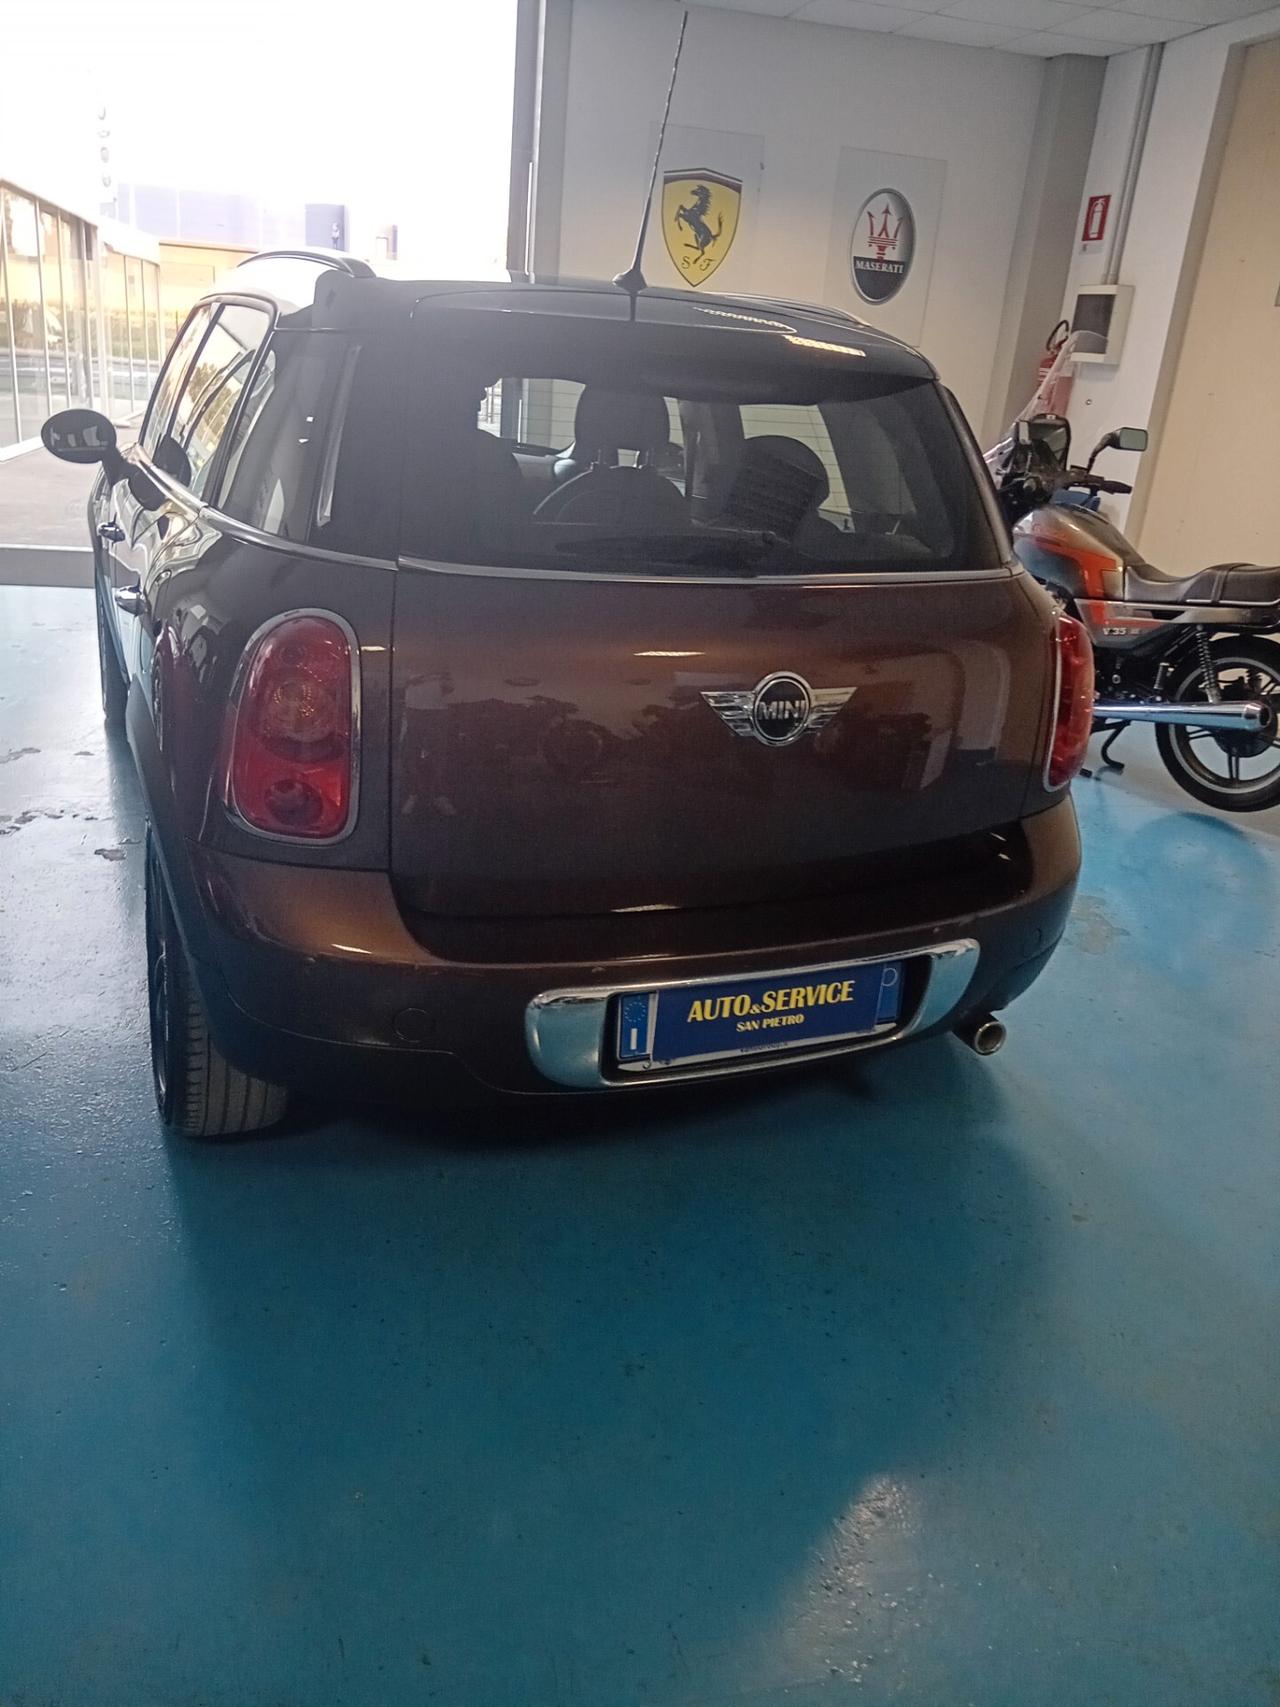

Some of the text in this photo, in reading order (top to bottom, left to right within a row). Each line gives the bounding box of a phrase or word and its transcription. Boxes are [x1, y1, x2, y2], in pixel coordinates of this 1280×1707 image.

[681, 256, 690, 269] S
[855, 260, 904, 273] MASERATI
[758, 700, 806, 720] MINI
[736, 1013, 805, 1032] SAN PIETRO
